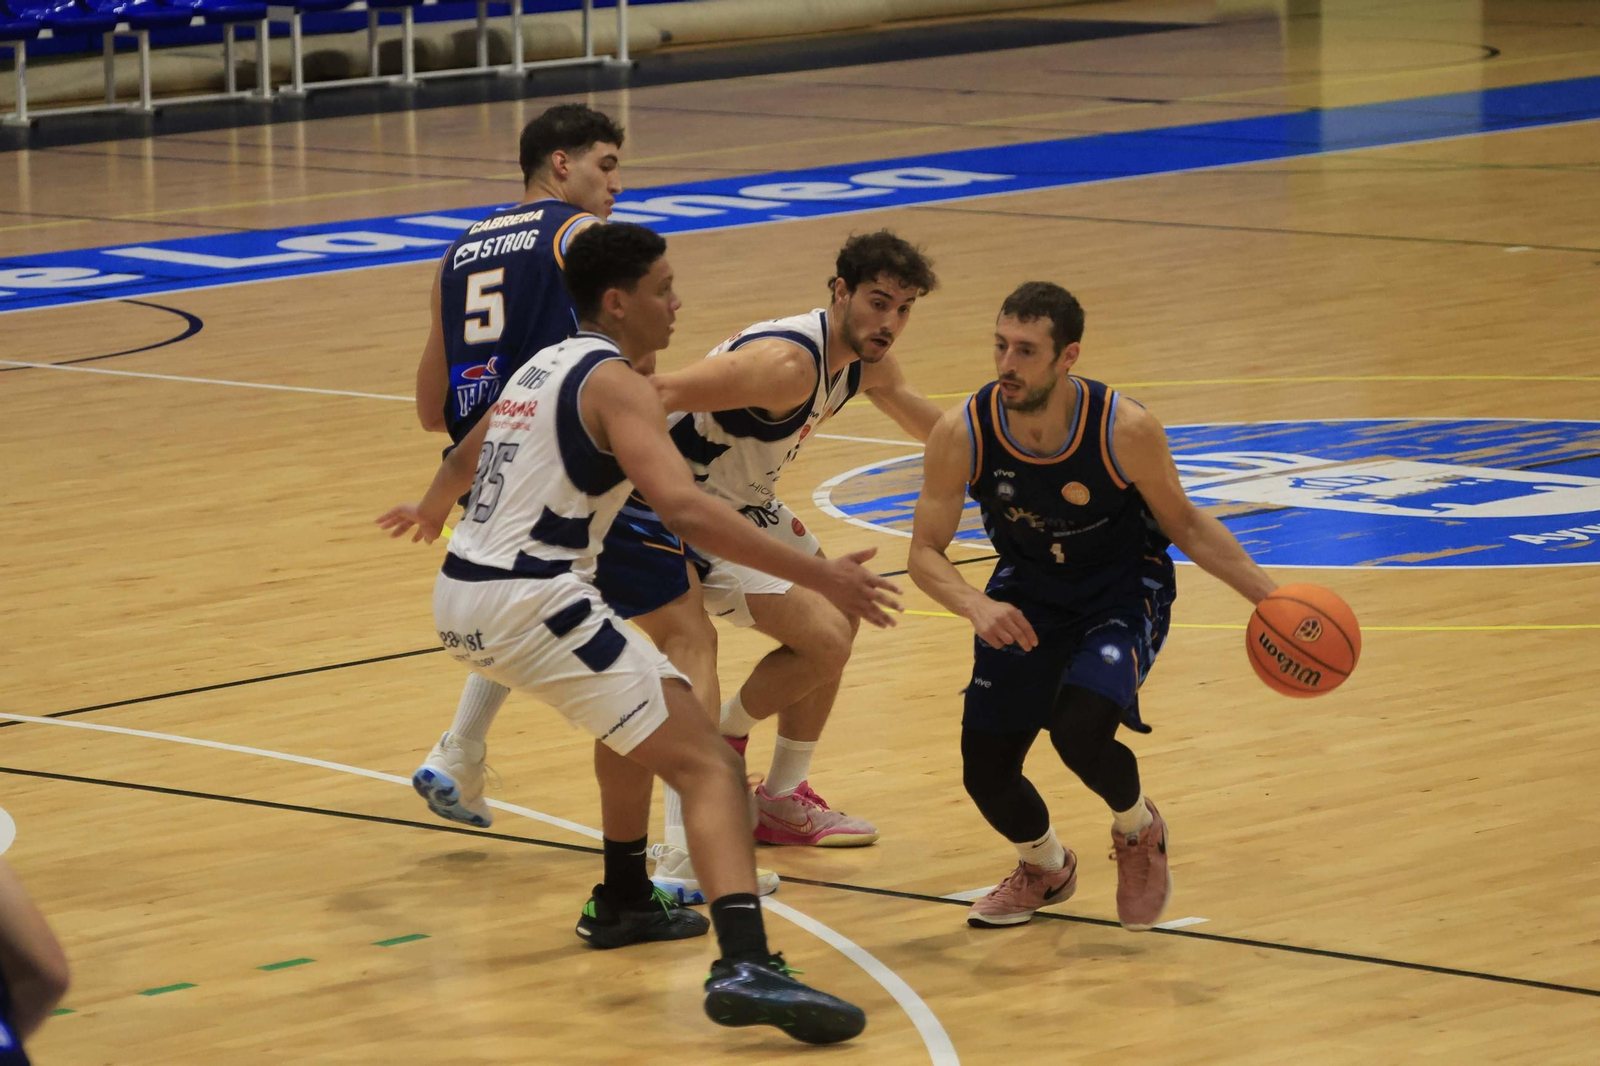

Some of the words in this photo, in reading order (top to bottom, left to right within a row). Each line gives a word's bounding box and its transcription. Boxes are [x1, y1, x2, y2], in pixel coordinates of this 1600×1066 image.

[468, 208, 545, 235] CABRERA
[100, 230, 453, 269] La
[480, 229, 540, 259] STROG
[463, 267, 505, 346] 5
[993, 468, 1016, 479] vive
[1258, 632, 1322, 687] Wilson
[974, 676, 992, 689] vive
